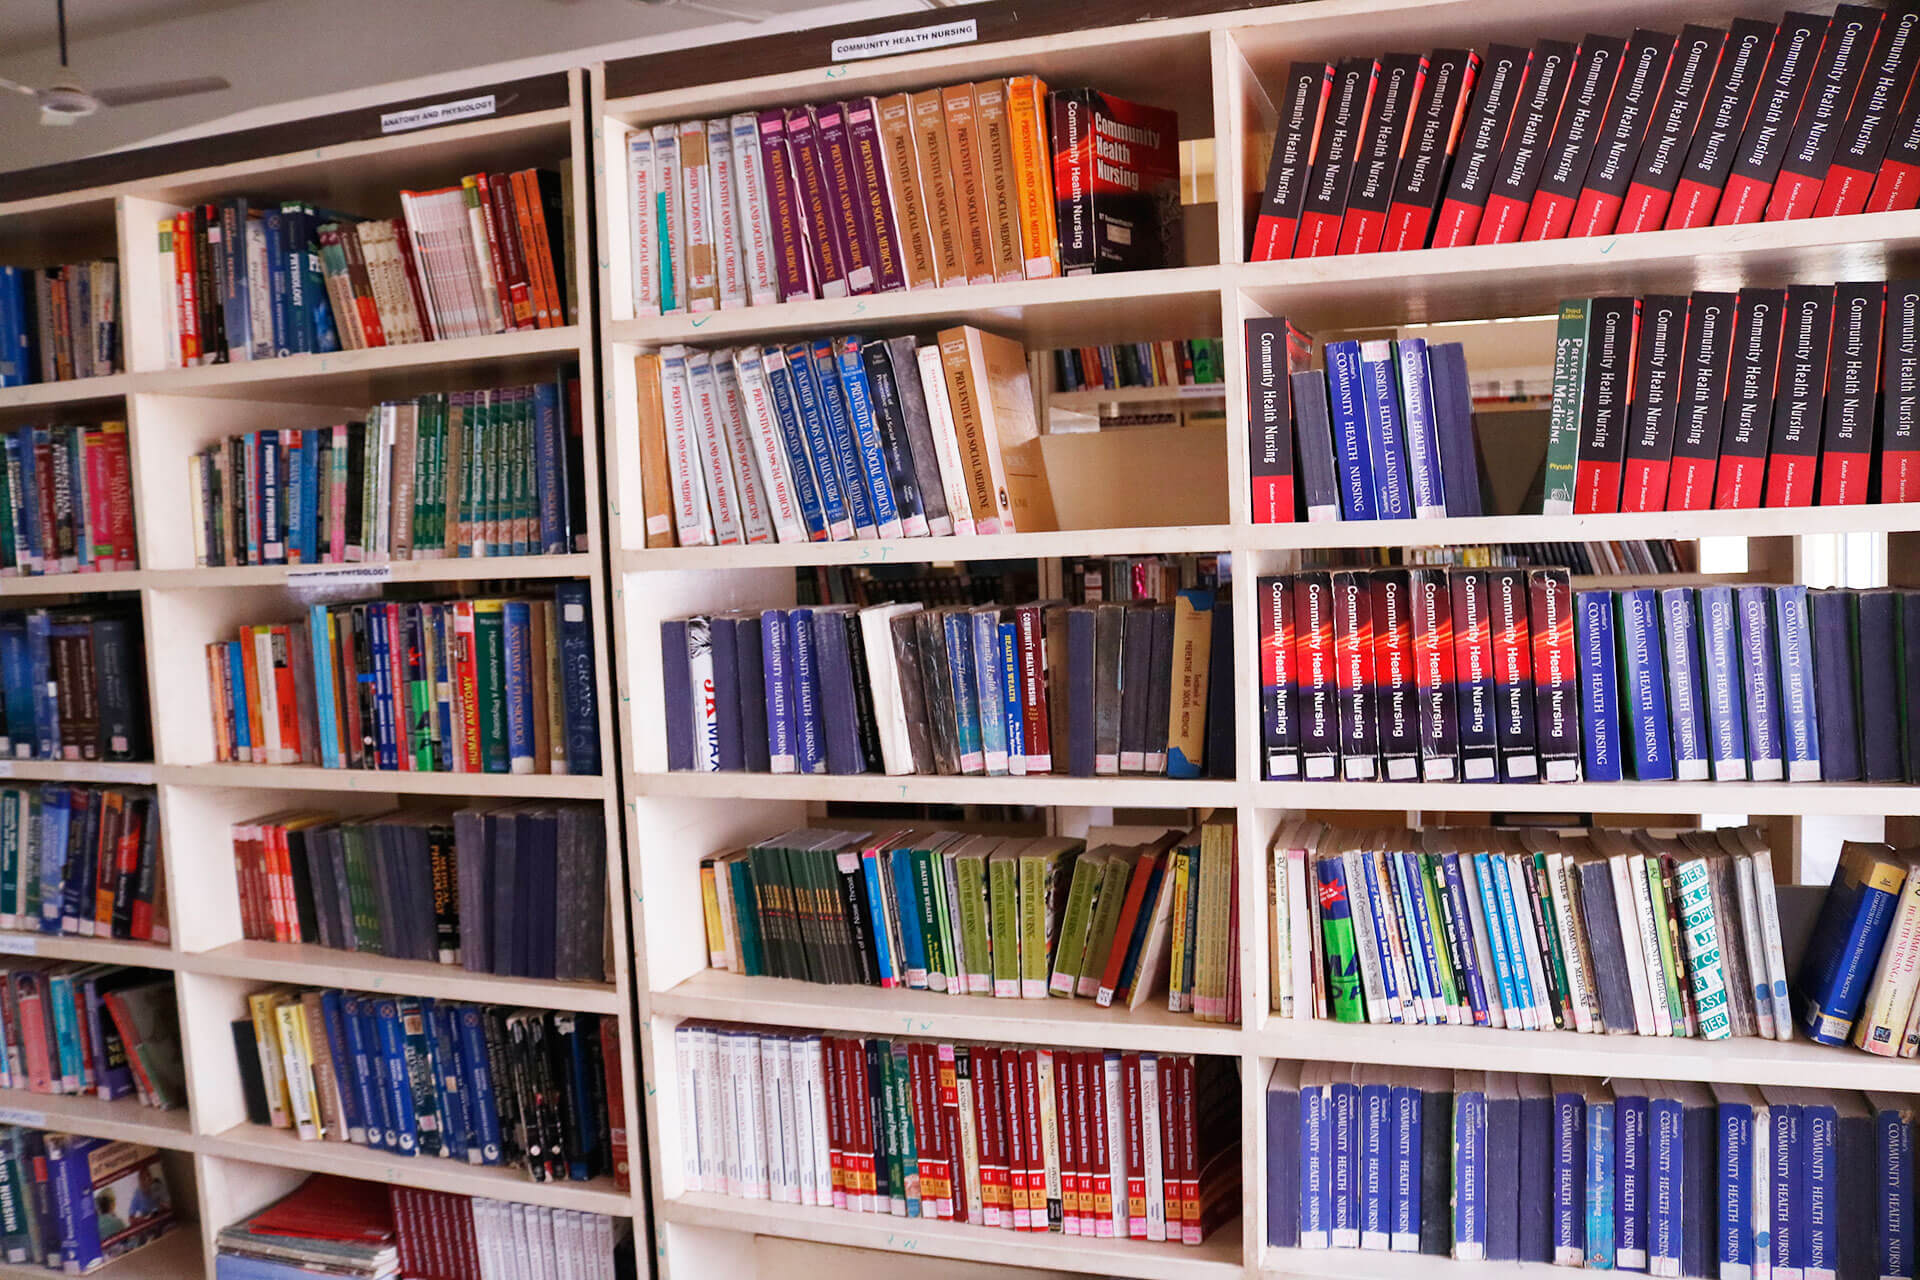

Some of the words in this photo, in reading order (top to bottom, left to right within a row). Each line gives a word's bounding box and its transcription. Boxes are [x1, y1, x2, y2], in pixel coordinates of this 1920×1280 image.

[838, 40, 890, 53] COMMUNITY
[893, 34, 928, 44] HEALTH
[931, 26, 972, 39] NURSING
[1828, 23, 1862, 81] Community
[1725, 36, 1758, 92] Community
[1289, 76, 1312, 129] Community
[1428, 63, 1454, 117] Community
[1484, 60, 1512, 115] Community
[1817, 85, 1841, 117] Health
[384, 115, 419, 126] ANATOMY
[422, 111, 438, 119] AND
[441, 101, 492, 116] PHYSIOLOGY
[1095, 112, 1160, 148] Community
[1715, 96, 1738, 127] Health
[988, 123, 1002, 173] PREVENTIVE
[1066, 101, 1078, 163] Community
[1096, 136, 1131, 164] Health
[1284, 134, 1301, 163] Health
[1421, 121, 1439, 151] Health
[1476, 118, 1496, 149] Health
[1699, 132, 1726, 170] Nursing
[1800, 122, 1828, 161] Nursing
[771, 150, 786, 196] PREVENTIVE
[860, 139, 877, 188] PREVENTIVE
[894, 135, 910, 184] PREVENTIVE
[1097, 159, 1140, 190] Nursing
[1408, 155, 1430, 192] Nursing
[1462, 153, 1486, 190] Nursing
[869, 188, 880, 206] AND
[903, 184, 913, 202] AND
[994, 174, 1004, 191] AND
[1070, 166, 1081, 201] Health
[1274, 168, 1294, 204] Nursing
[777, 199, 788, 214] AND
[872, 206, 885, 234] SOCIAL
[905, 202, 918, 230] SOCIAL
[995, 191, 1007, 220] SOCIAL
[780, 215, 792, 242] SOCIAL
[999, 222, 1012, 263] MEDICINE
[1071, 204, 1082, 248] Nursing
[783, 245, 797, 284] MEDICINE
[877, 235, 892, 276] MEDICINE
[910, 232, 925, 272] MEDICINE
[1600, 312, 1620, 368] Community
[1746, 304, 1768, 362] Community
[1845, 298, 1867, 356] Community
[1261, 333, 1275, 387] Community
[1845, 361, 1862, 393] Health
[796, 369, 815, 408] MEDICINE
[1336, 352, 1352, 416] COMMUNITY
[1374, 361, 1388, 399] NURSIN
[1599, 373, 1614, 404] Health
[1744, 367, 1761, 398] Health
[806, 408, 822, 436] SOCIAL
[850, 381, 870, 429] PREVENTIVE
[1264, 391, 1277, 422] Health
[1736, 404, 1756, 442] Nursing
[1839, 399, 1858, 438] Nursing
[813, 436, 827, 454] AND
[861, 429, 874, 448] AND
[1264, 426, 1278, 463] Nursing
[1344, 421, 1358, 460] HEALTH
[1592, 410, 1611, 447] Nursing
[817, 453, 839, 502] PREVENTIVE
[865, 447, 881, 477] SOCIAL
[872, 477, 890, 517] MEDICINE
[1349, 464, 1364, 511] NURSING
[1271, 582, 1284, 647] Community
[1384, 583, 1399, 649] Community
[1500, 576, 1516, 644] Community
[796, 620, 809, 677] COMMUNITY
[1004, 635, 1013, 662] HEALTH
[1022, 613, 1033, 650] COMMUNITY
[1587, 602, 1601, 668] COMMUNITY
[1632, 600, 1647, 664] COMMUNITY
[1025, 651, 1035, 676] HEALTH
[1274, 649, 1286, 686] Health
[1389, 650, 1402, 689] Health
[1506, 646, 1519, 685] Health
[463, 676, 475, 725] ANATOMY
[801, 681, 811, 716] HEALTH
[1006, 671, 1015, 702] WEALTH
[1027, 677, 1037, 706] NURSING
[1591, 673, 1604, 713] HEALTH
[1639, 669, 1652, 710] HEALTH
[1274, 689, 1288, 734] Nursing
[1390, 691, 1404, 737] Nursing
[1507, 687, 1522, 734] Nursing
[466, 727, 478, 765] HUMAN
[804, 720, 816, 760] NURSING
[1594, 719, 1607, 764] NURSING
[1643, 715, 1657, 762] NURSING
[1565, 913, 1581, 963] COMMUNITY
[1574, 966, 1589, 1007] MEDICINE
[1399, 1199, 1409, 1232] NURSIN
[1562, 1210, 1572, 1247] NURSIN
[1728, 1227, 1737, 1262] NURSIN
